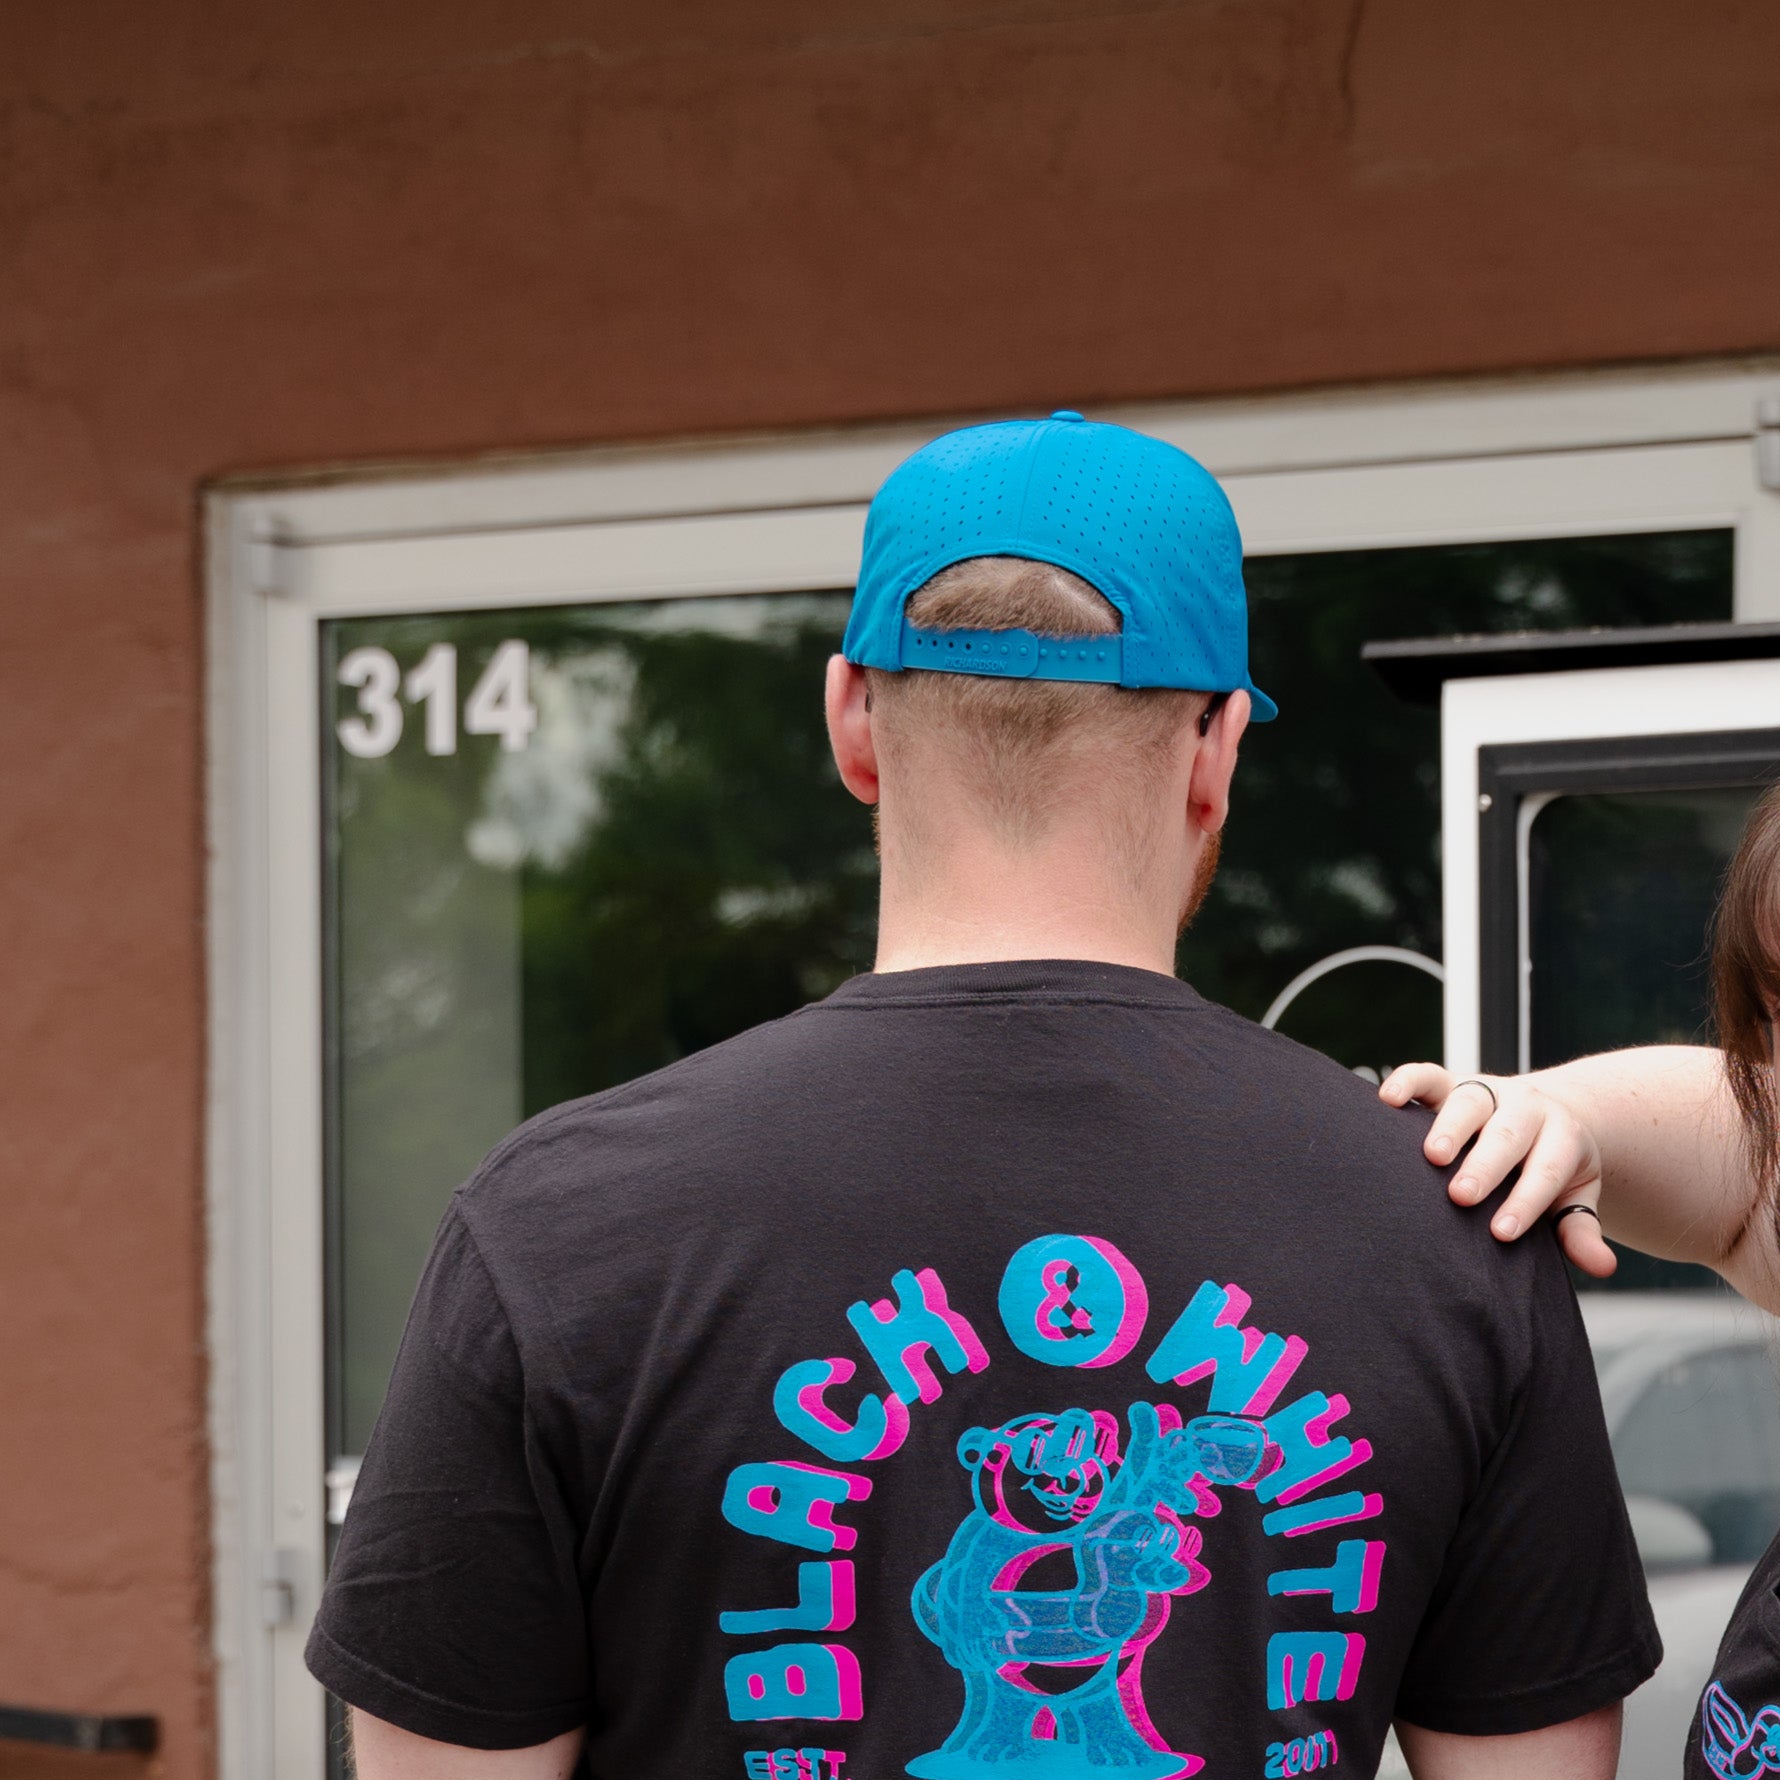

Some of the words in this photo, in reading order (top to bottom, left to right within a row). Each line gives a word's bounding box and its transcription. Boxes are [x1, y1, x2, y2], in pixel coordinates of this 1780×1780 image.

[334, 638, 539, 758] 314
[943, 656, 1008, 671] RICHARDSON
[720, 1267, 990, 1721] BLACK
[1145, 1280, 1386, 1711] WHITE
